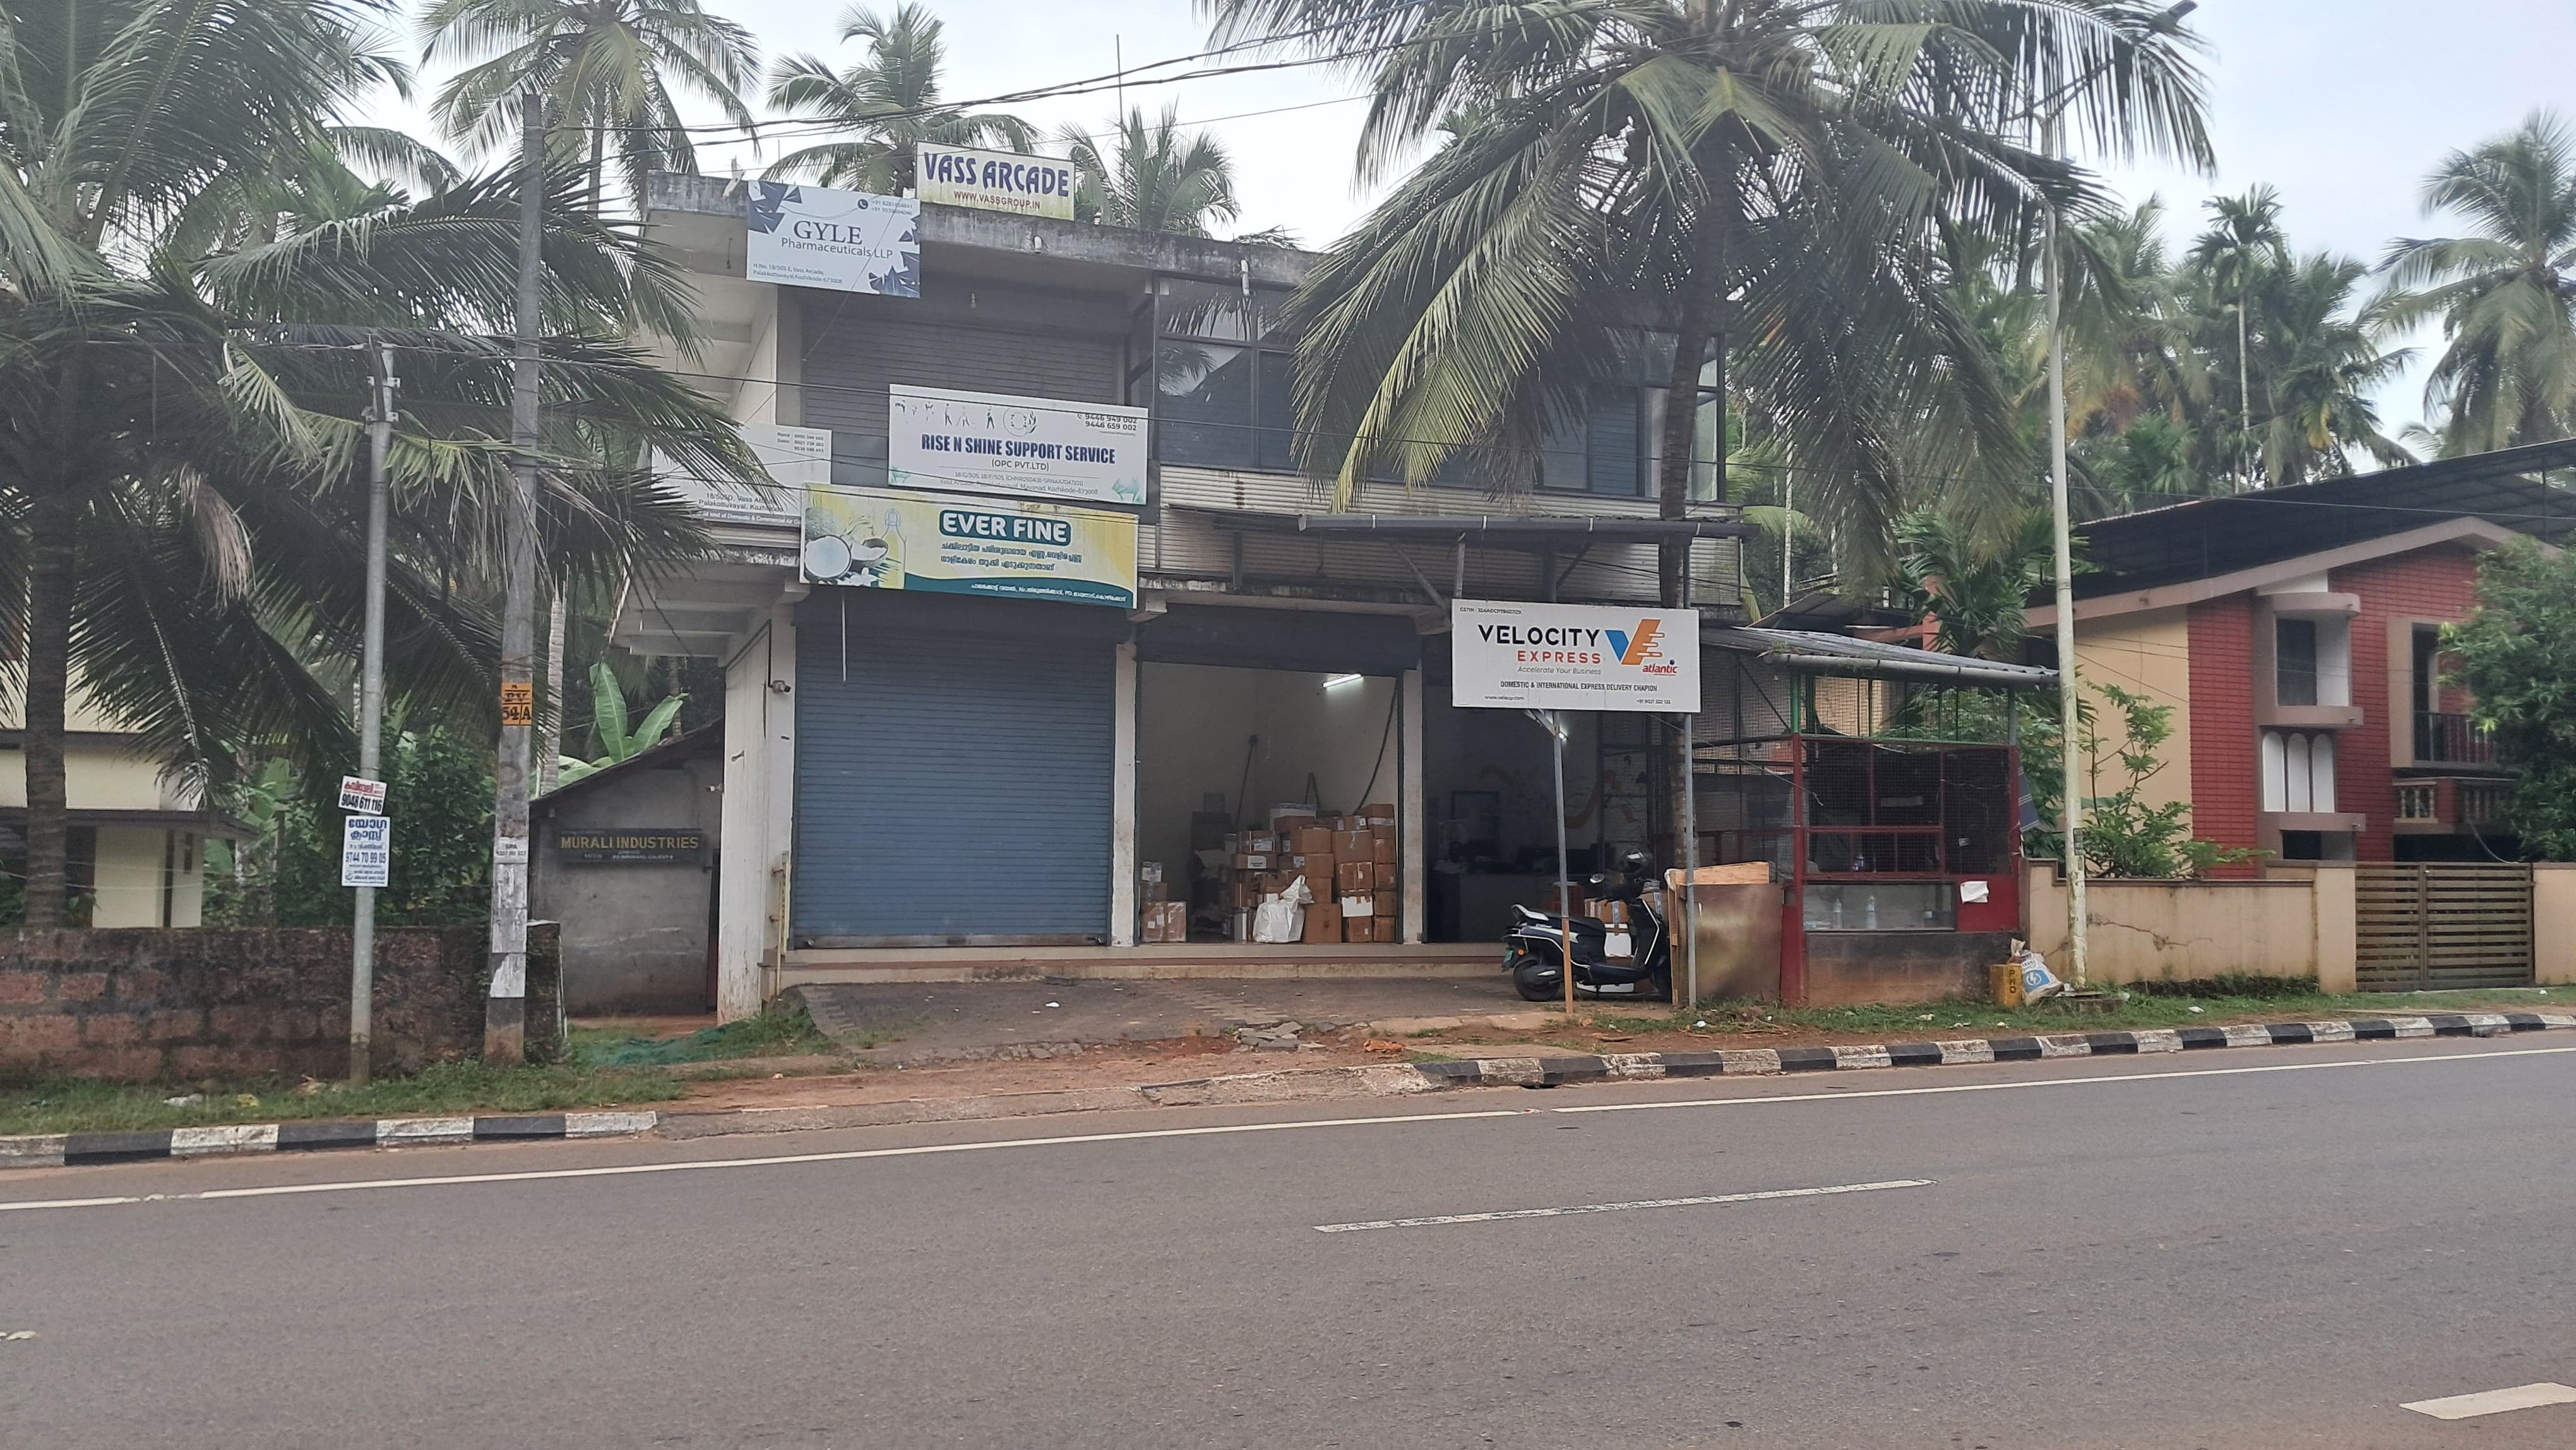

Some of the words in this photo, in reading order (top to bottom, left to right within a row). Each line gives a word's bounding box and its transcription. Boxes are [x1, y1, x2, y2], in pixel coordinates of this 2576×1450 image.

[924, 152, 976, 185] VASS
[982, 160, 1068, 197] ARCADE
[954, 191, 1041, 210] WWW.VASSGROUP.IN
[793, 220, 863, 245] GYLE
[782, 237, 871, 257] Pharmaceuticals
[874, 248, 893, 259] LLP
[921, 434, 950, 452] RISE
[953, 436, 962, 452] N
[965, 436, 1003, 455] SHINE
[1005, 440, 1063, 460] SUPPORT
[1065, 445, 1116, 464] SERVICE
[992, 458, 1011, 468] (OPC
[1015, 460, 1049, 471] PVT.LTD)
[943, 512, 1007, 537] EVER
[1013, 519, 1068, 543] FINE
[1477, 624, 1601, 647] VELOCITY
[1517, 650, 1601, 664] EXPRESS
[1642, 661, 1678, 674] atlantic
[1537, 681, 1579, 690] INTERNATIONAL
[1606, 683, 1632, 692] DELIVERY
[342, 793, 359, 808] 9048
[359, 796, 371, 810] 611
[371, 798, 383, 812] 116
[349, 818, 387, 829] യോഗ
[561, 836, 613, 849] MURALI
[616, 836, 699, 849] INDUSTRIES
[345, 851, 360, 863] 9744
[361, 851, 369, 863] 70
[370, 852, 378, 863] 99
[379, 852, 386, 864] 05
